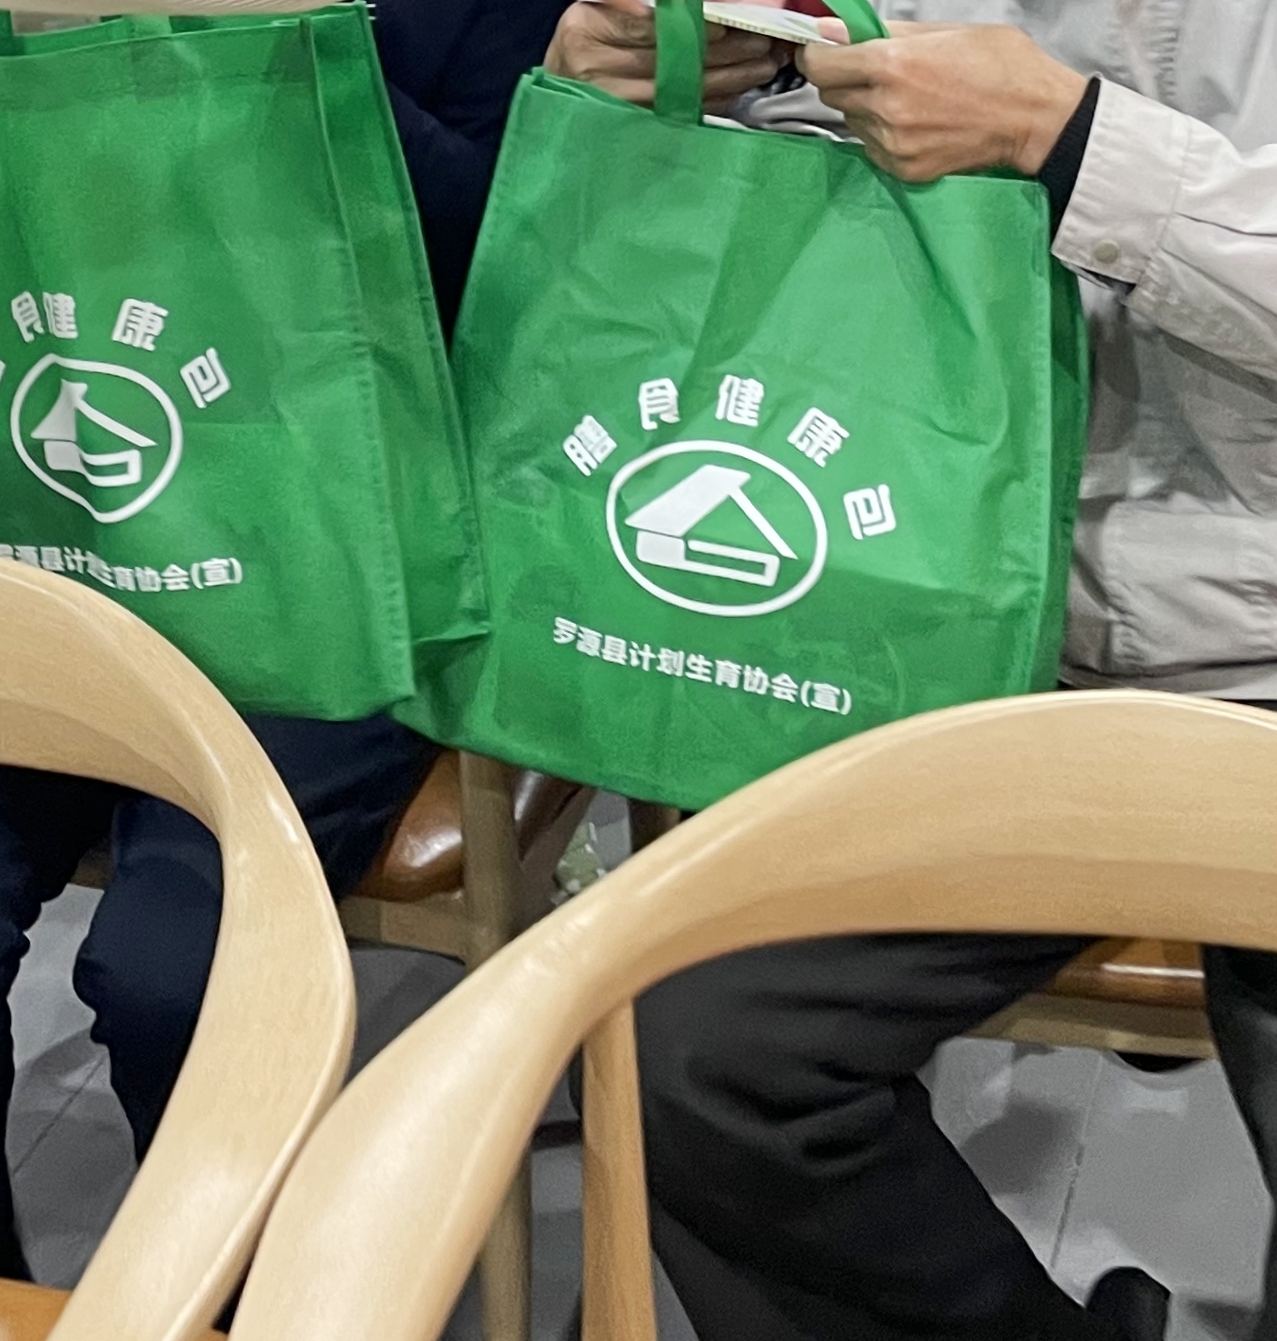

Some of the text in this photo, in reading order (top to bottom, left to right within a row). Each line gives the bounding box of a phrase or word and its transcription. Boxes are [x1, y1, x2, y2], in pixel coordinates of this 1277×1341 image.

[562, 373, 897, 541] 膳食健康包
[553, 616, 852, 716] 罗源县计划生育协会(宣)
